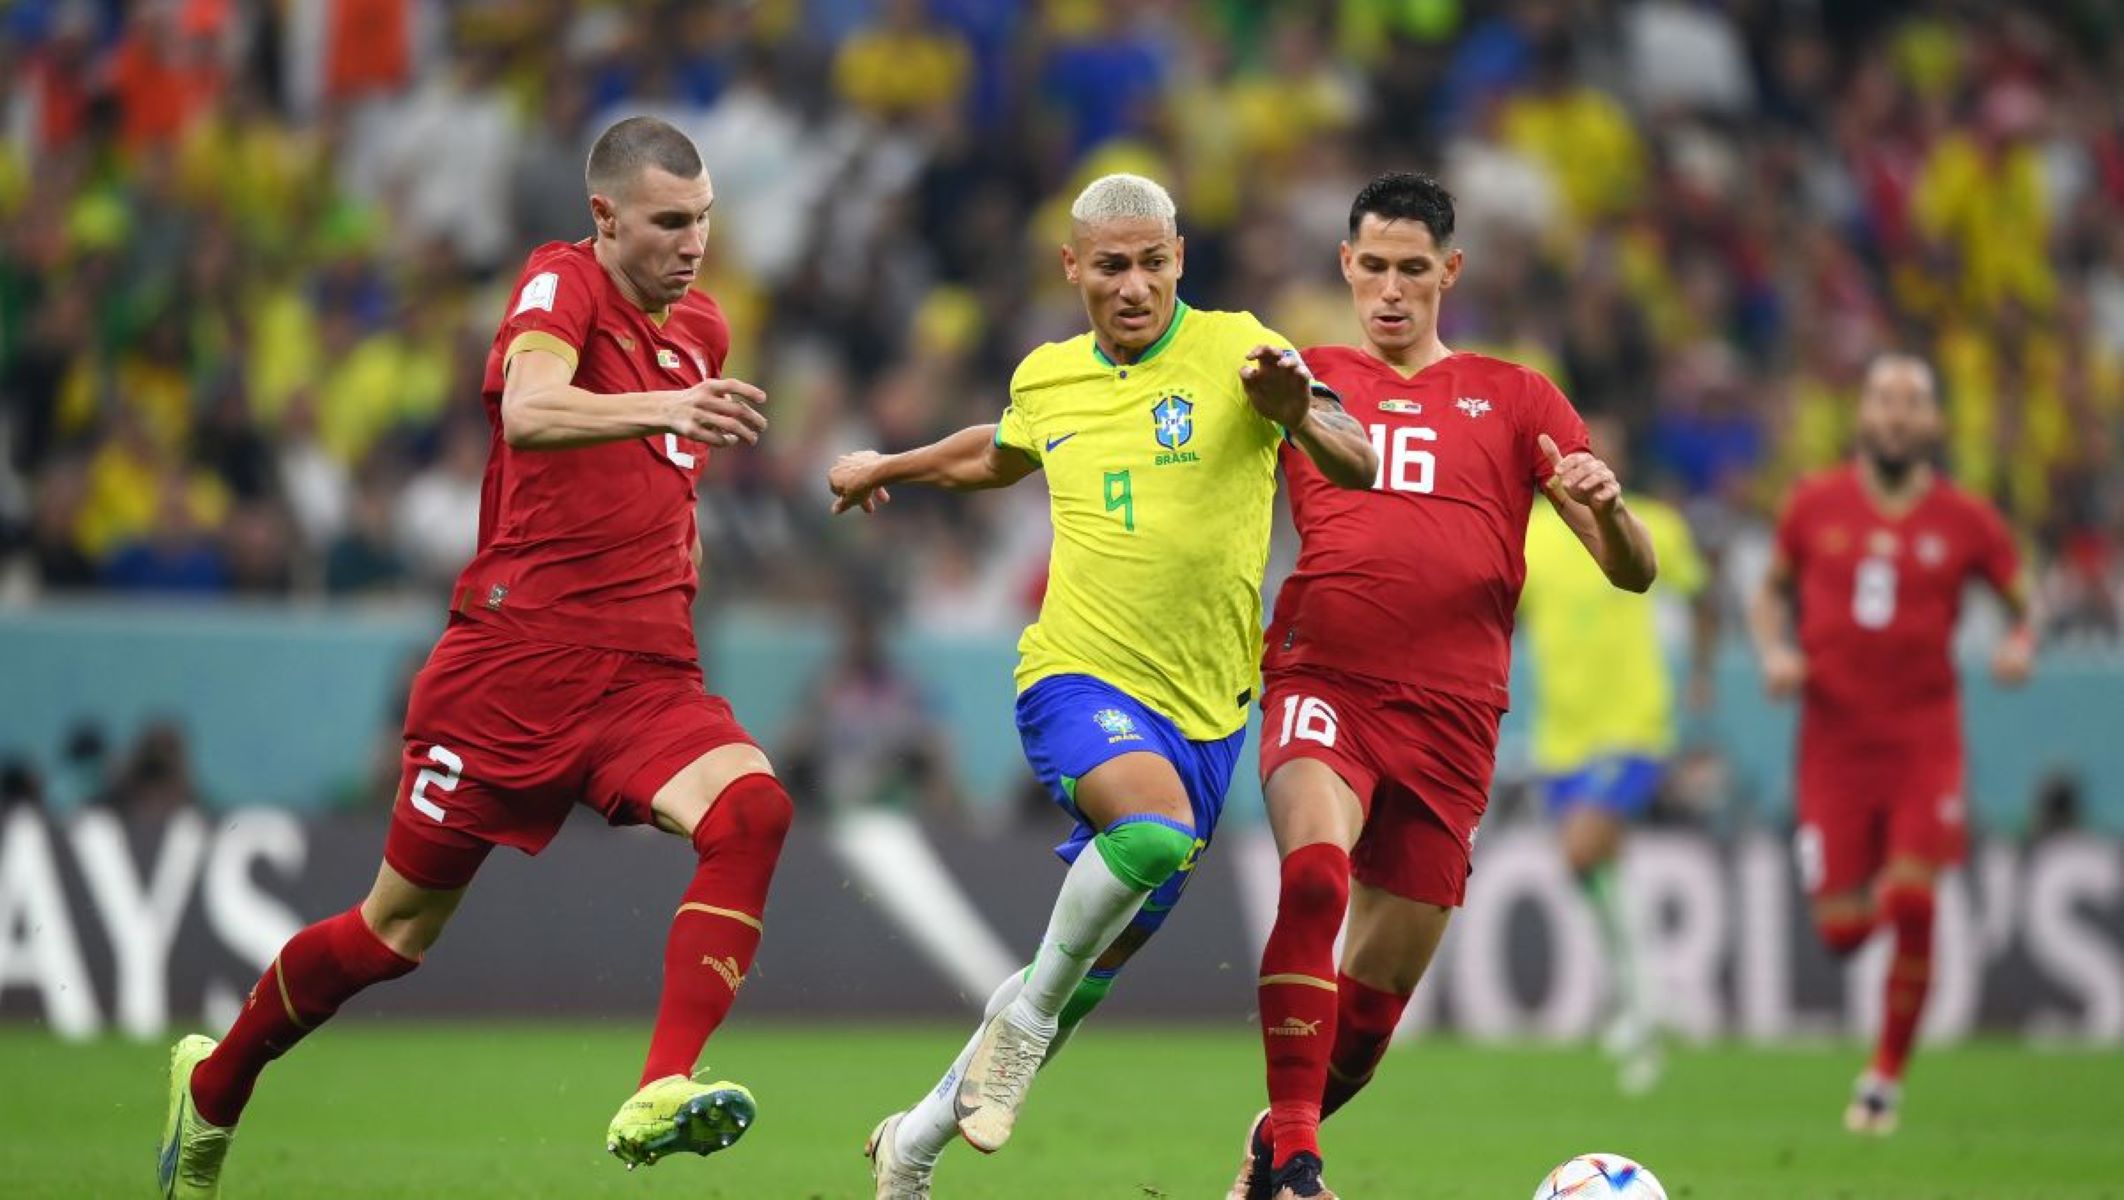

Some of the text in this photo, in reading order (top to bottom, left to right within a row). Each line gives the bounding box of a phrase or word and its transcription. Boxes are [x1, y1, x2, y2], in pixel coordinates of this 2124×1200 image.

[1155, 451, 1200, 466] BRASIL
[1369, 423, 1438, 493] 16
[1104, 470, 1134, 531] 9
[1279, 694, 1338, 748] 16
[410, 744, 463, 823] 2
[1232, 826, 2124, 1048] ORLD'S
